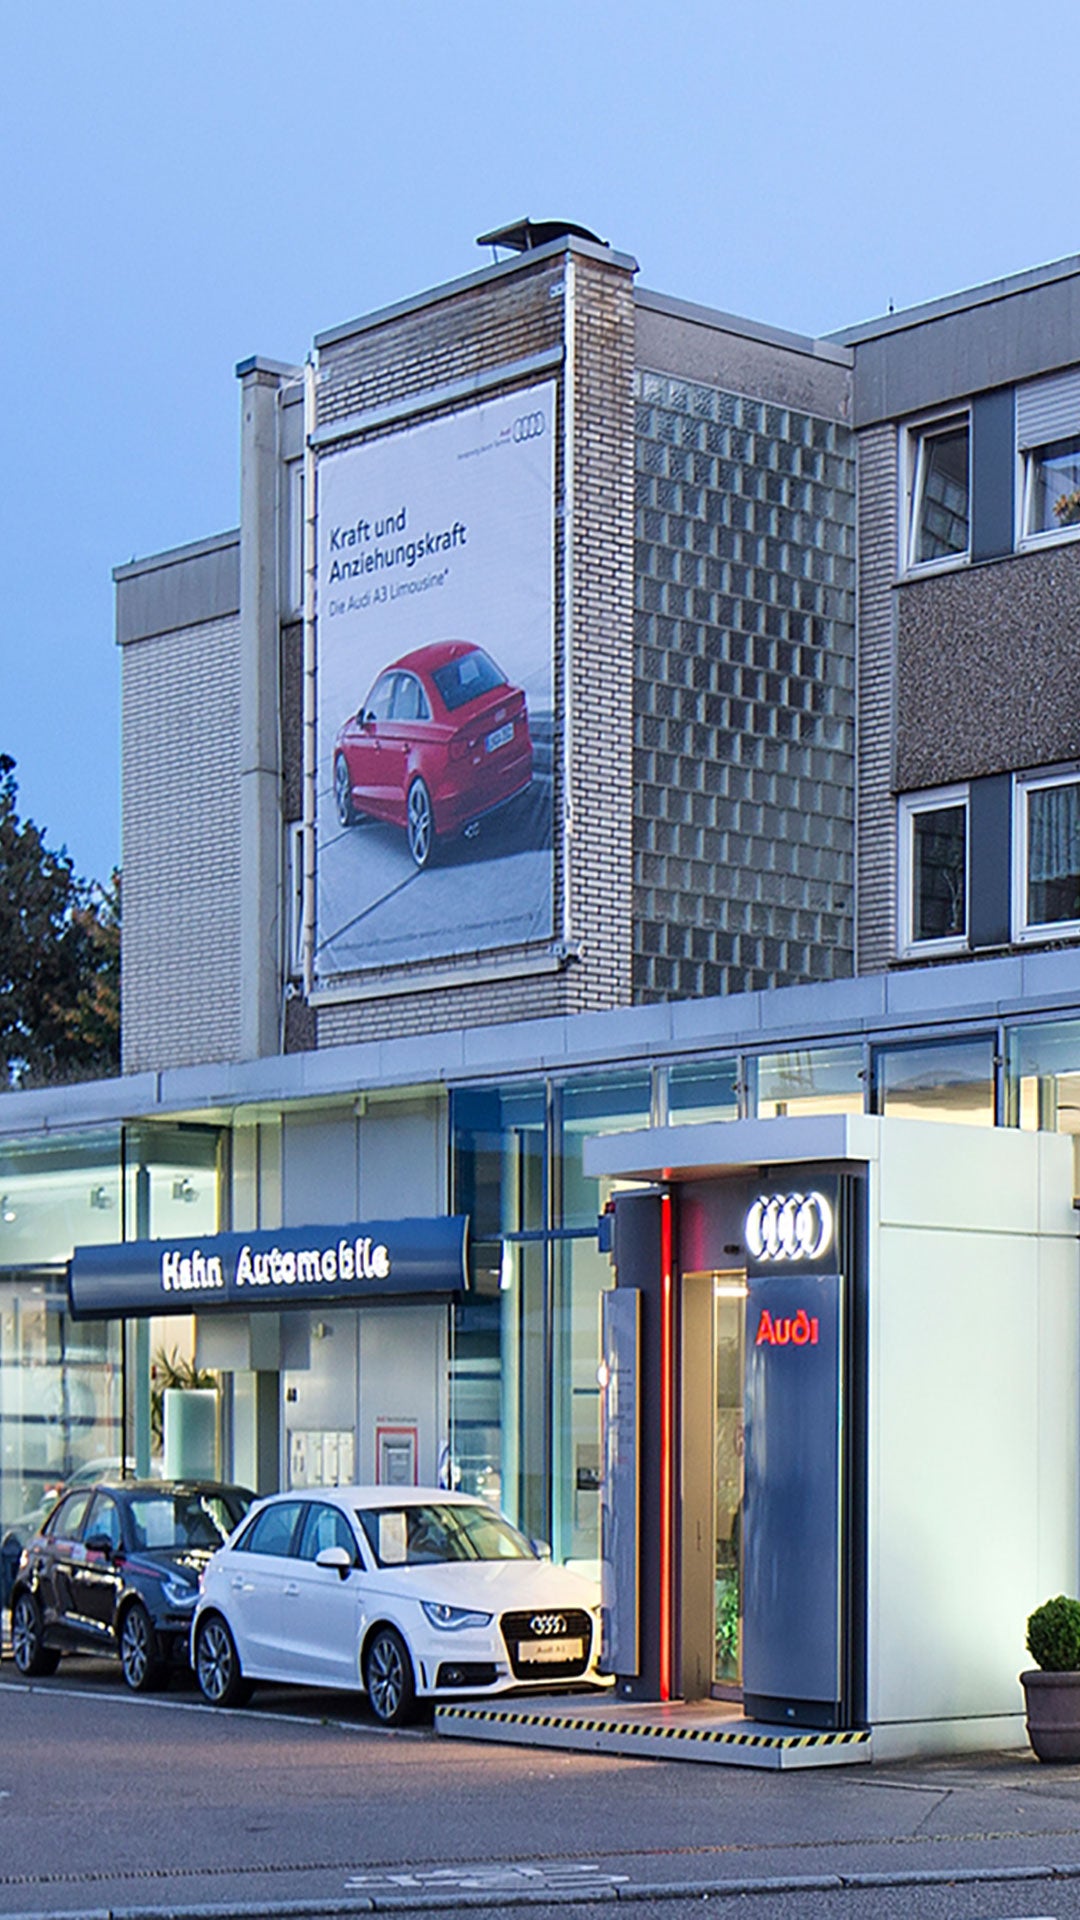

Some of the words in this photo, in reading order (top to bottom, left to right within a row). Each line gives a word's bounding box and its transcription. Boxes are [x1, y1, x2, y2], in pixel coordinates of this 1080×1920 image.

[329, 519, 370, 552] Kraft
[374, 507, 406, 538] und
[329, 521, 467, 584] Anziehungskraft
[329, 598, 345, 617] Die
[347, 591, 371, 613] Audi
[373, 585, 387, 604] A3
[162, 1249, 224, 1291] Hahn
[236, 1237, 390, 1286] Automobile
[756, 1309, 819, 1346] Audi
